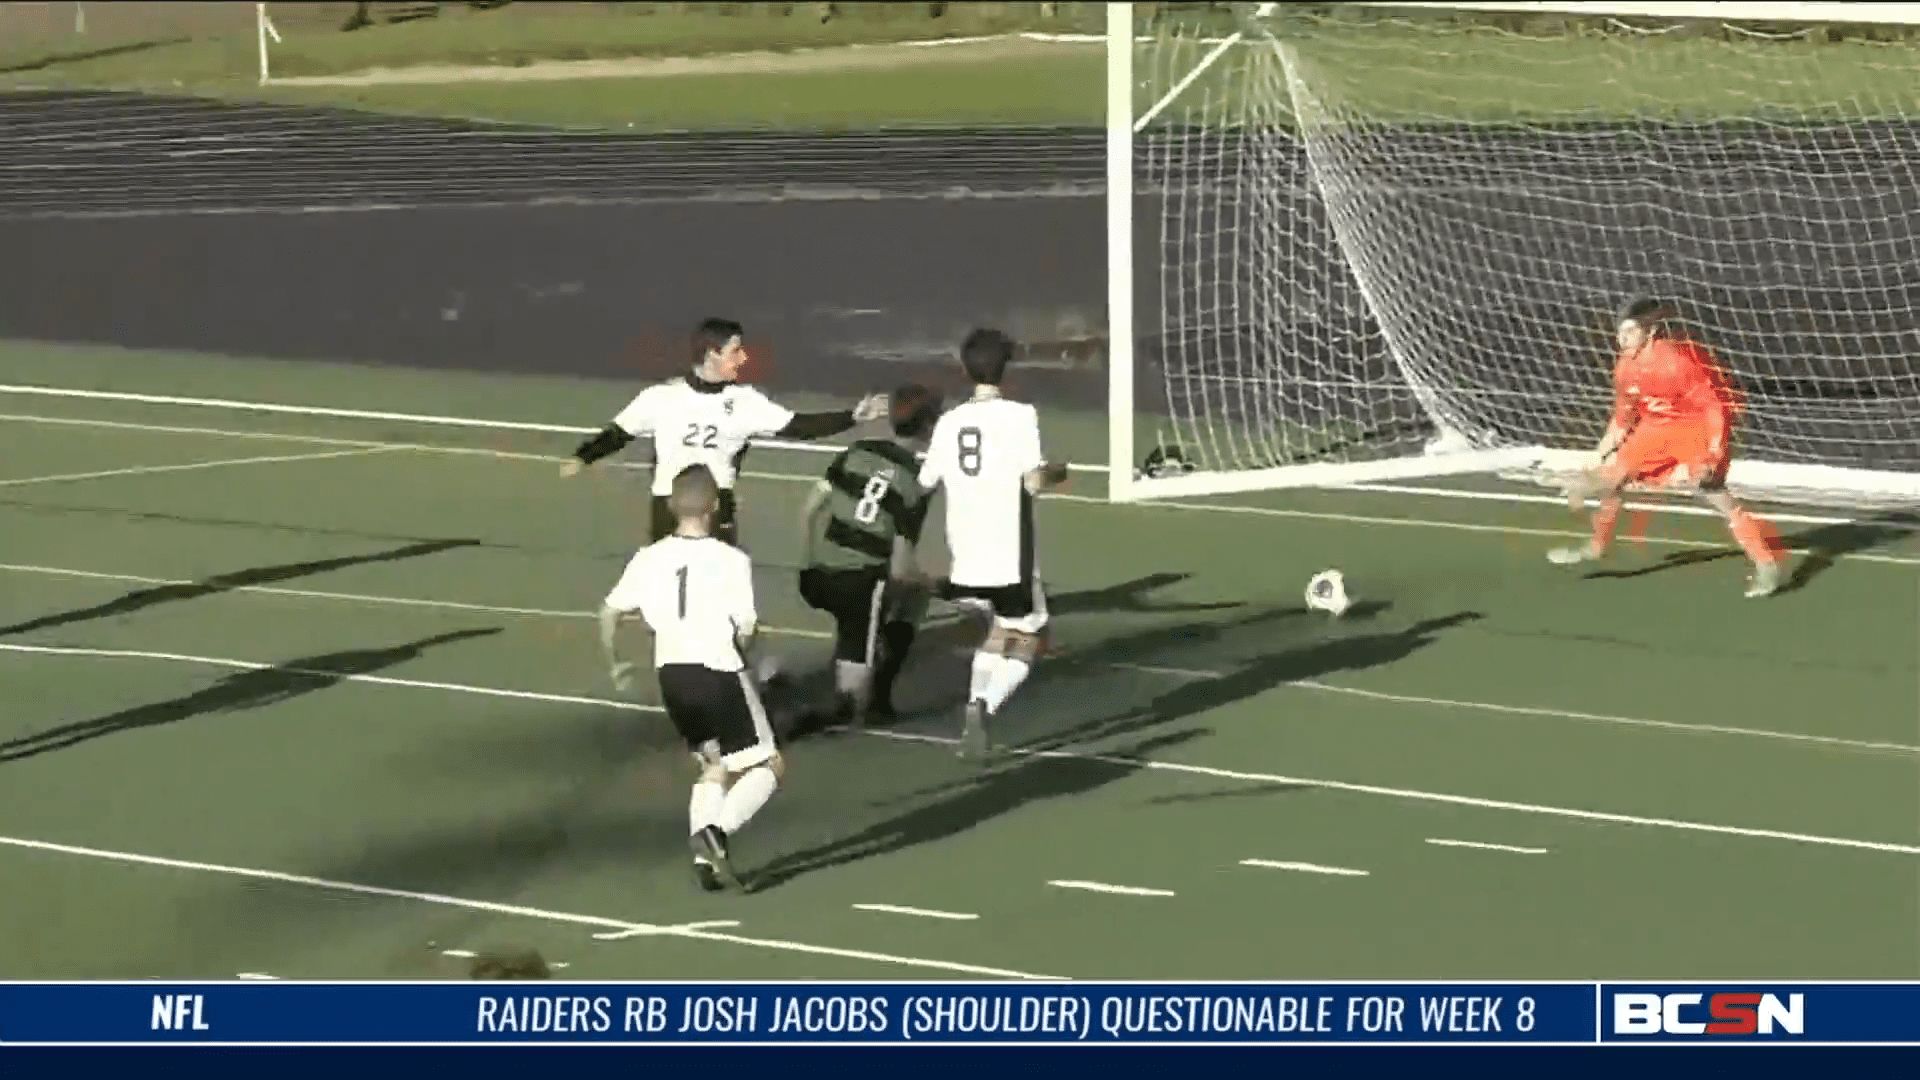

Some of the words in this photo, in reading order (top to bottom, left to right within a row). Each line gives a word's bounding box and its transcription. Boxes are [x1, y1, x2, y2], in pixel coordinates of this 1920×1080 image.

[682, 422, 719, 449] 22
[957, 426, 982, 477] 8
[855, 476, 890, 525] 8
[675, 564, 688, 621] 1
